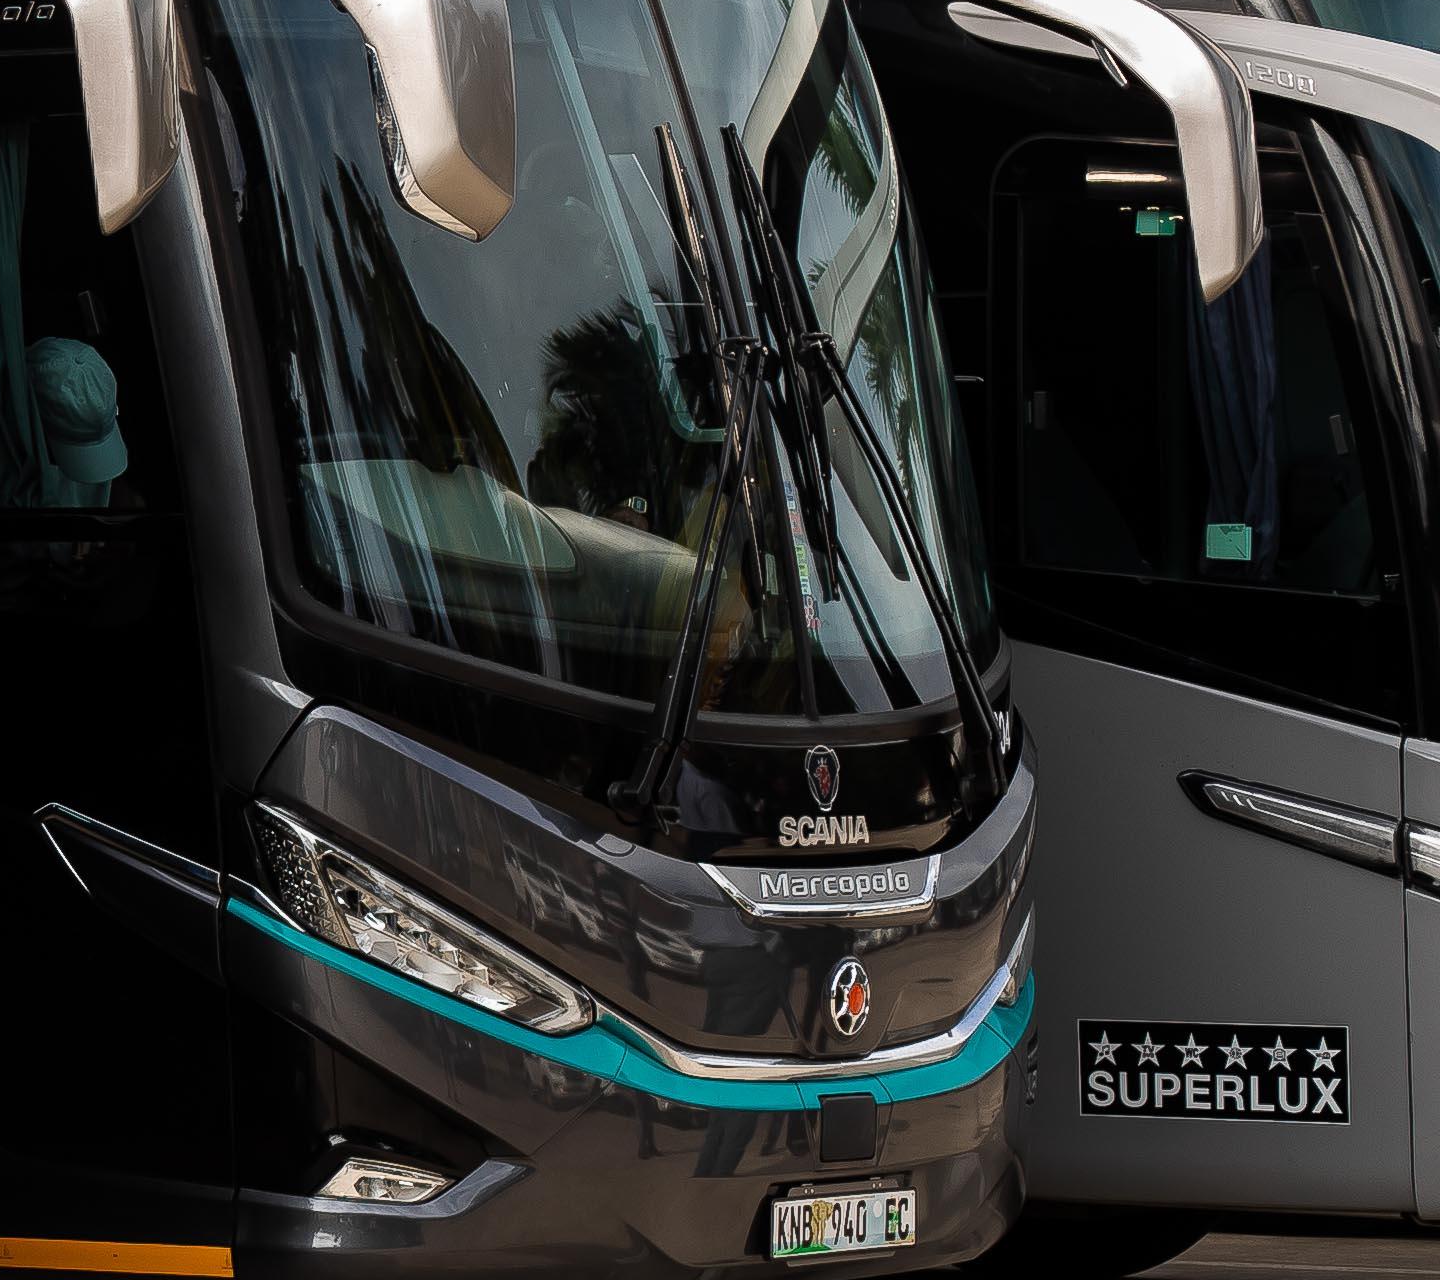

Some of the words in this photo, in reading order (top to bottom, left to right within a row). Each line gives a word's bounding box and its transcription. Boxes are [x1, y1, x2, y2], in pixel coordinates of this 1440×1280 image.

[1245, 61, 1318, 97] 1200
[779, 815, 870, 847] SCANIA
[759, 867, 911, 900] Marcopolo
[1087, 1070, 1344, 1115] SUPERLUX
[778, 1203, 814, 1251] KNB
[831, 1199, 868, 1246] 940
[884, 1197, 910, 1242] EC
